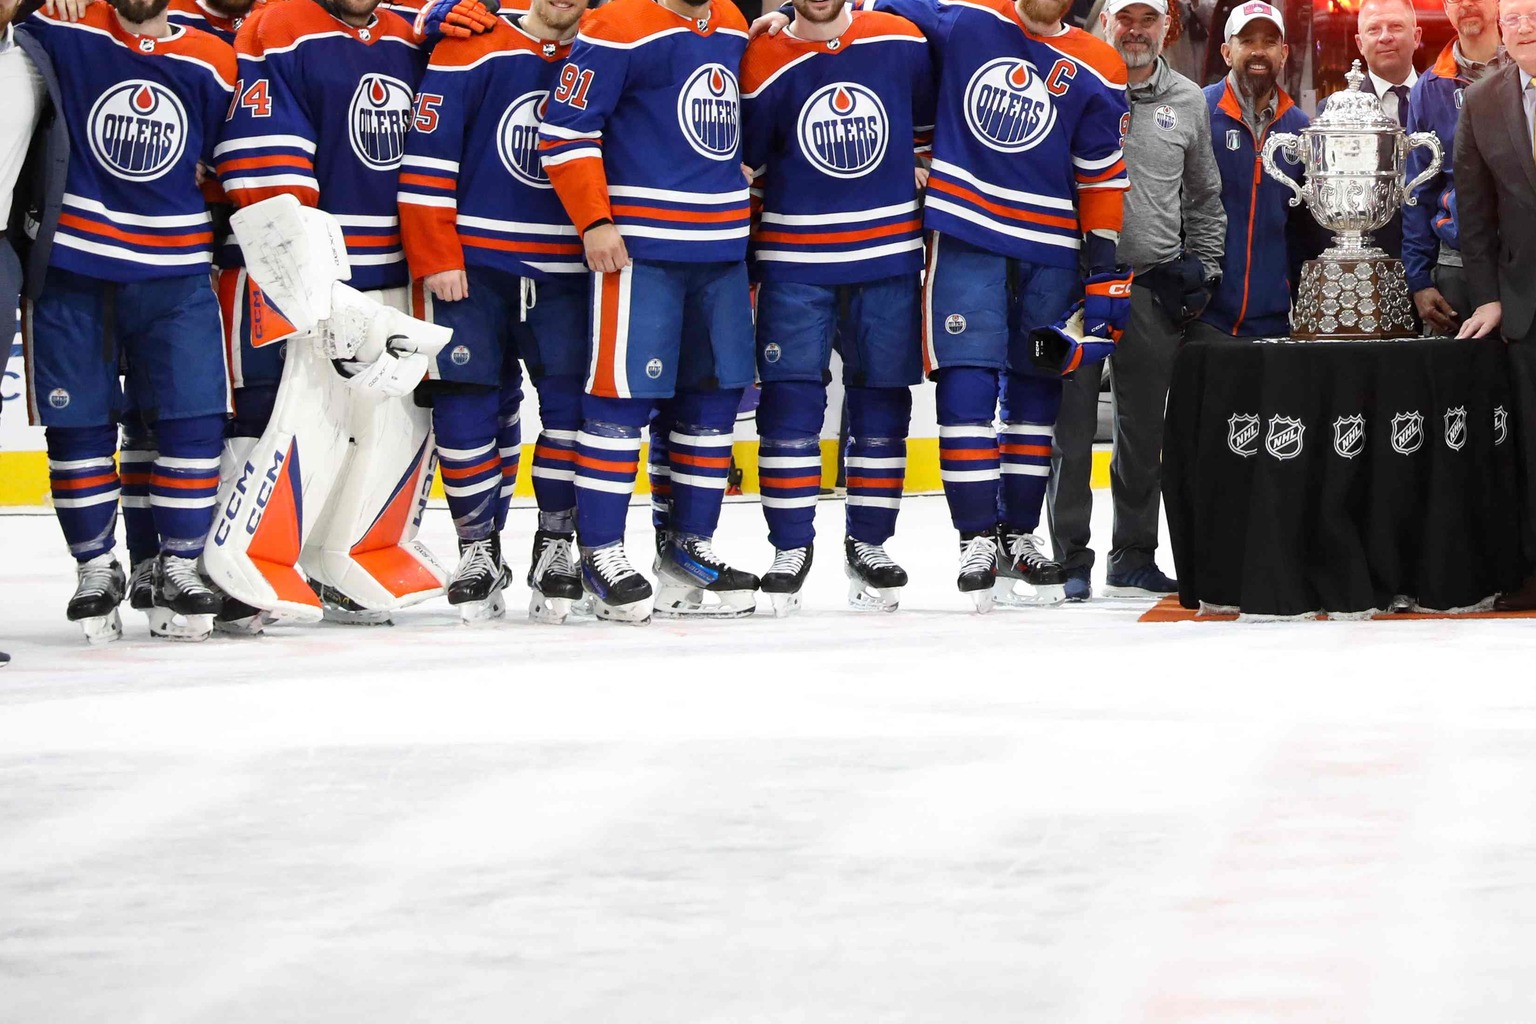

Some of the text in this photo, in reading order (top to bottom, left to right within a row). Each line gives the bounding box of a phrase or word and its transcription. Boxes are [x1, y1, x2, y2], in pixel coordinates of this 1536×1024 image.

[554, 63, 596, 111] 91
[1045, 58, 1079, 96] C
[359, 107, 411, 156] OILERS
[692, 96, 738, 146] OILERS
[978, 85, 1046, 138] OILERS
[1156, 112, 1177, 128] OILERS
[103, 111, 176, 163] OILERS
[812, 115, 879, 163] OILERS
[253, 290, 264, 339] CCM
[1091, 322, 1106, 334] CCM
[1235, 424, 1258, 447] NHL
[1273, 428, 1297, 448] NHL
[1342, 424, 1363, 449] NHL
[1398, 421, 1420, 447] NHL
[213, 460, 255, 548] CCM
[246, 449, 286, 535] CCM
